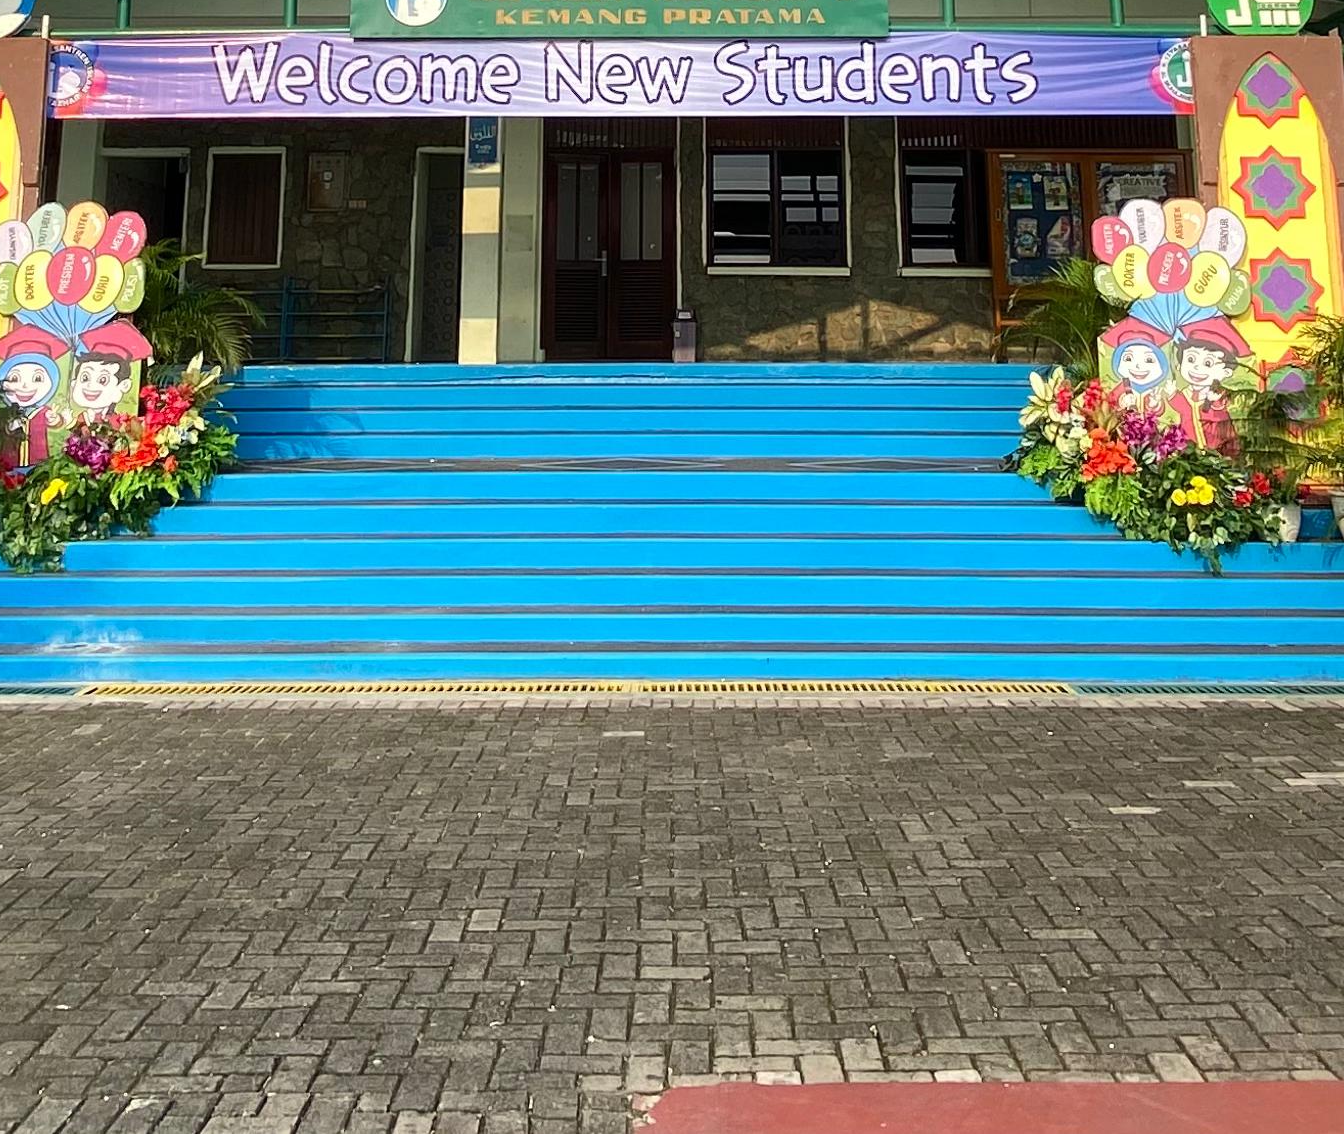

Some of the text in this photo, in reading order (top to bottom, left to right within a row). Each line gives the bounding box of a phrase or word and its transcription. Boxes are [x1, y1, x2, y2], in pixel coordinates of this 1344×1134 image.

[495, 8, 826, 26] KEMANG PRATAMA
[212, 39, 1039, 106] Welcome New Students
[25, 264, 35, 301] DOKTER
[92, 275, 110, 302] GURU
[1194, 264, 1218, 295] GURU
